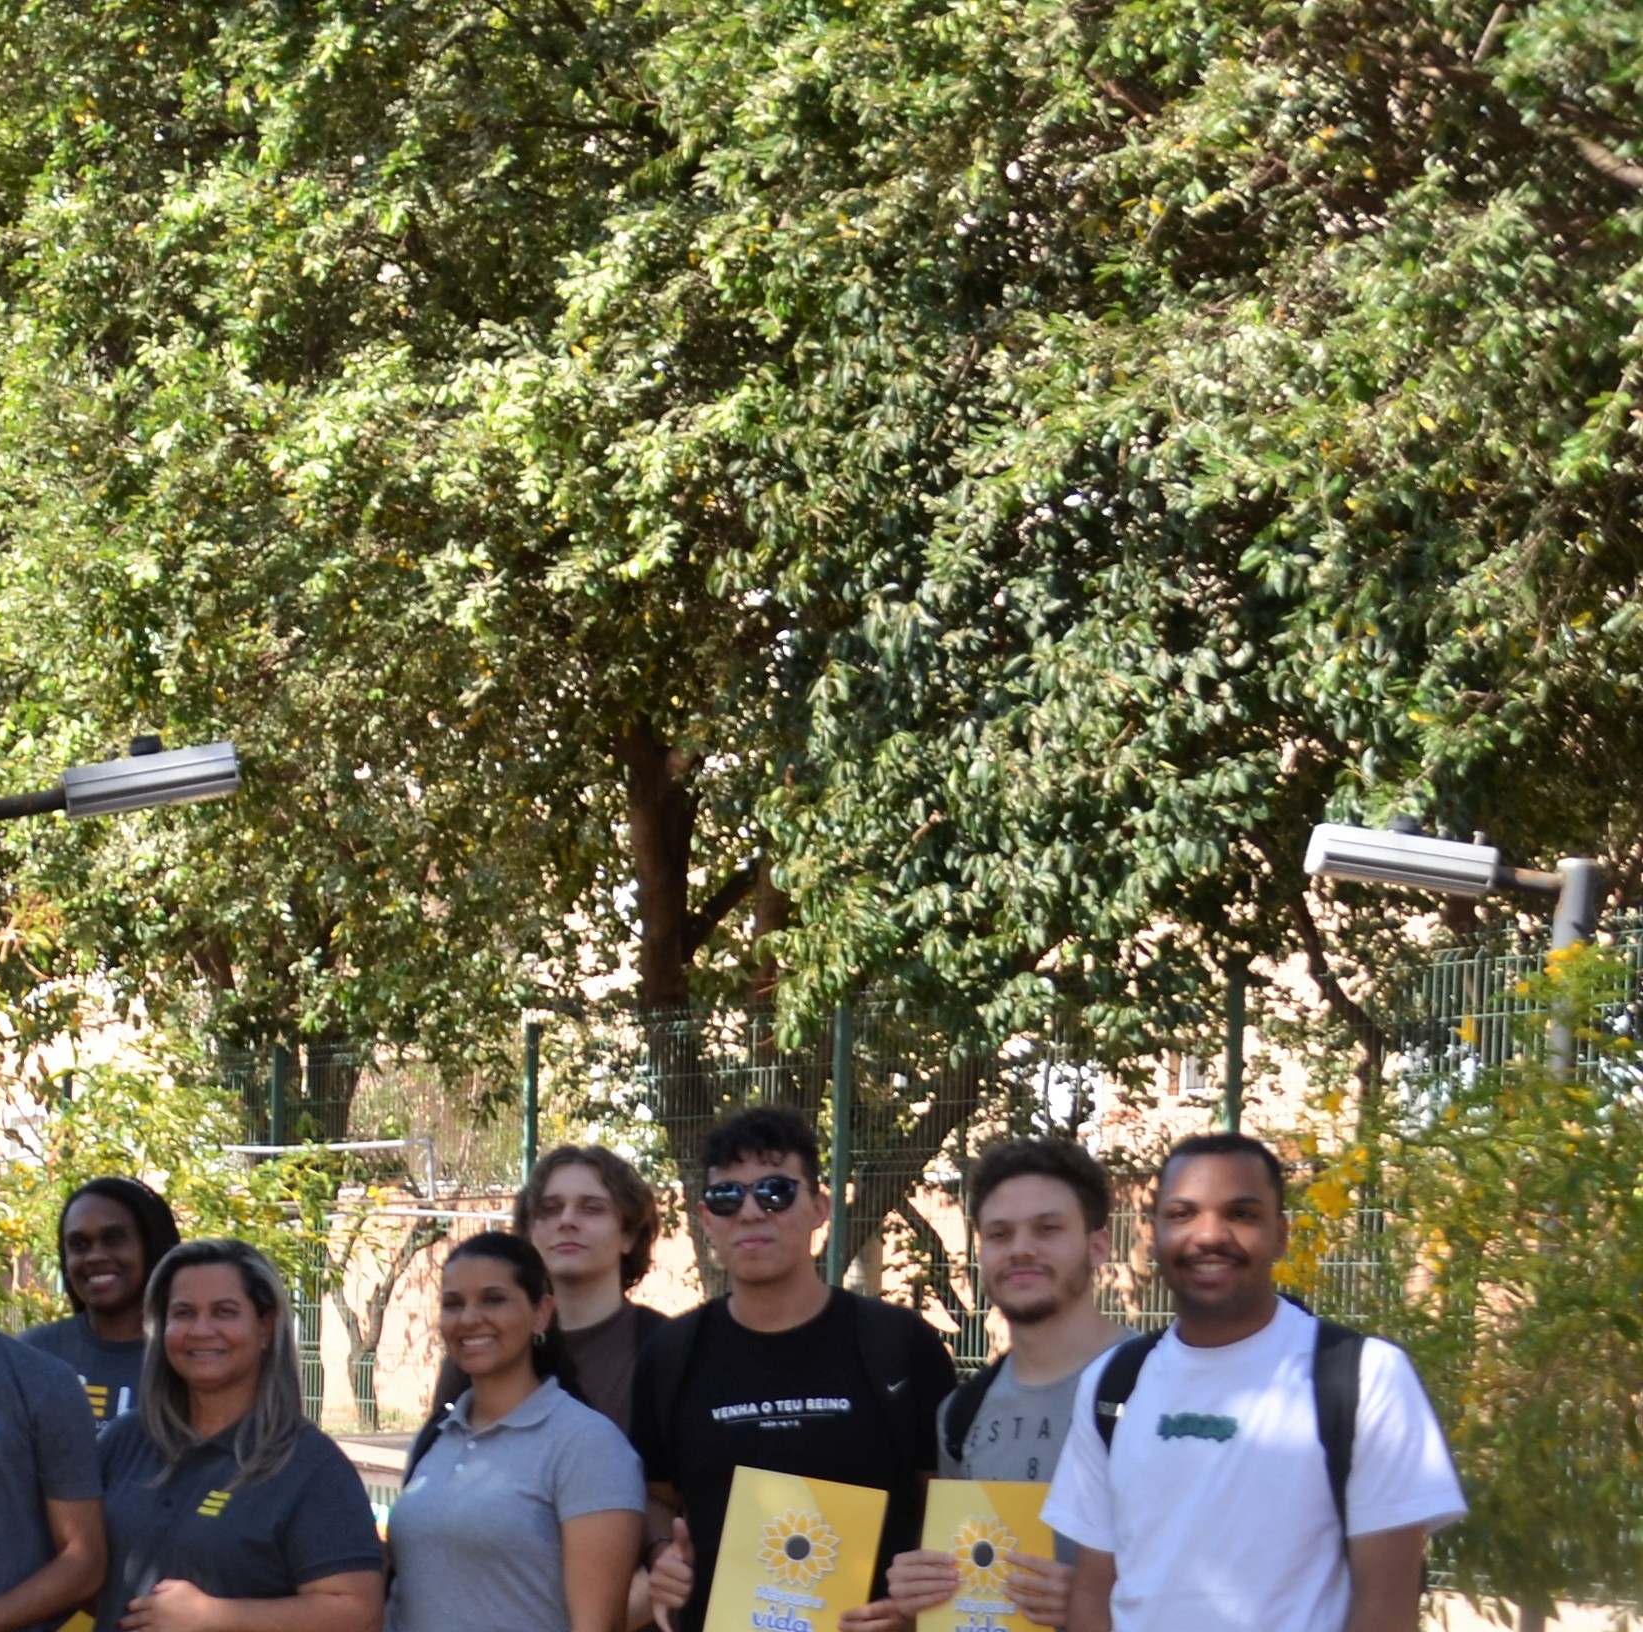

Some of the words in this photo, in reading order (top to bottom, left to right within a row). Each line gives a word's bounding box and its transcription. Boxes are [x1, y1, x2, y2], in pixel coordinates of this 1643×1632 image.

[712, 1402, 759, 1420] VENHA
[761, 1401, 773, 1413] O
[775, 1399, 803, 1412] TEU
[806, 1398, 851, 1410] REINO
